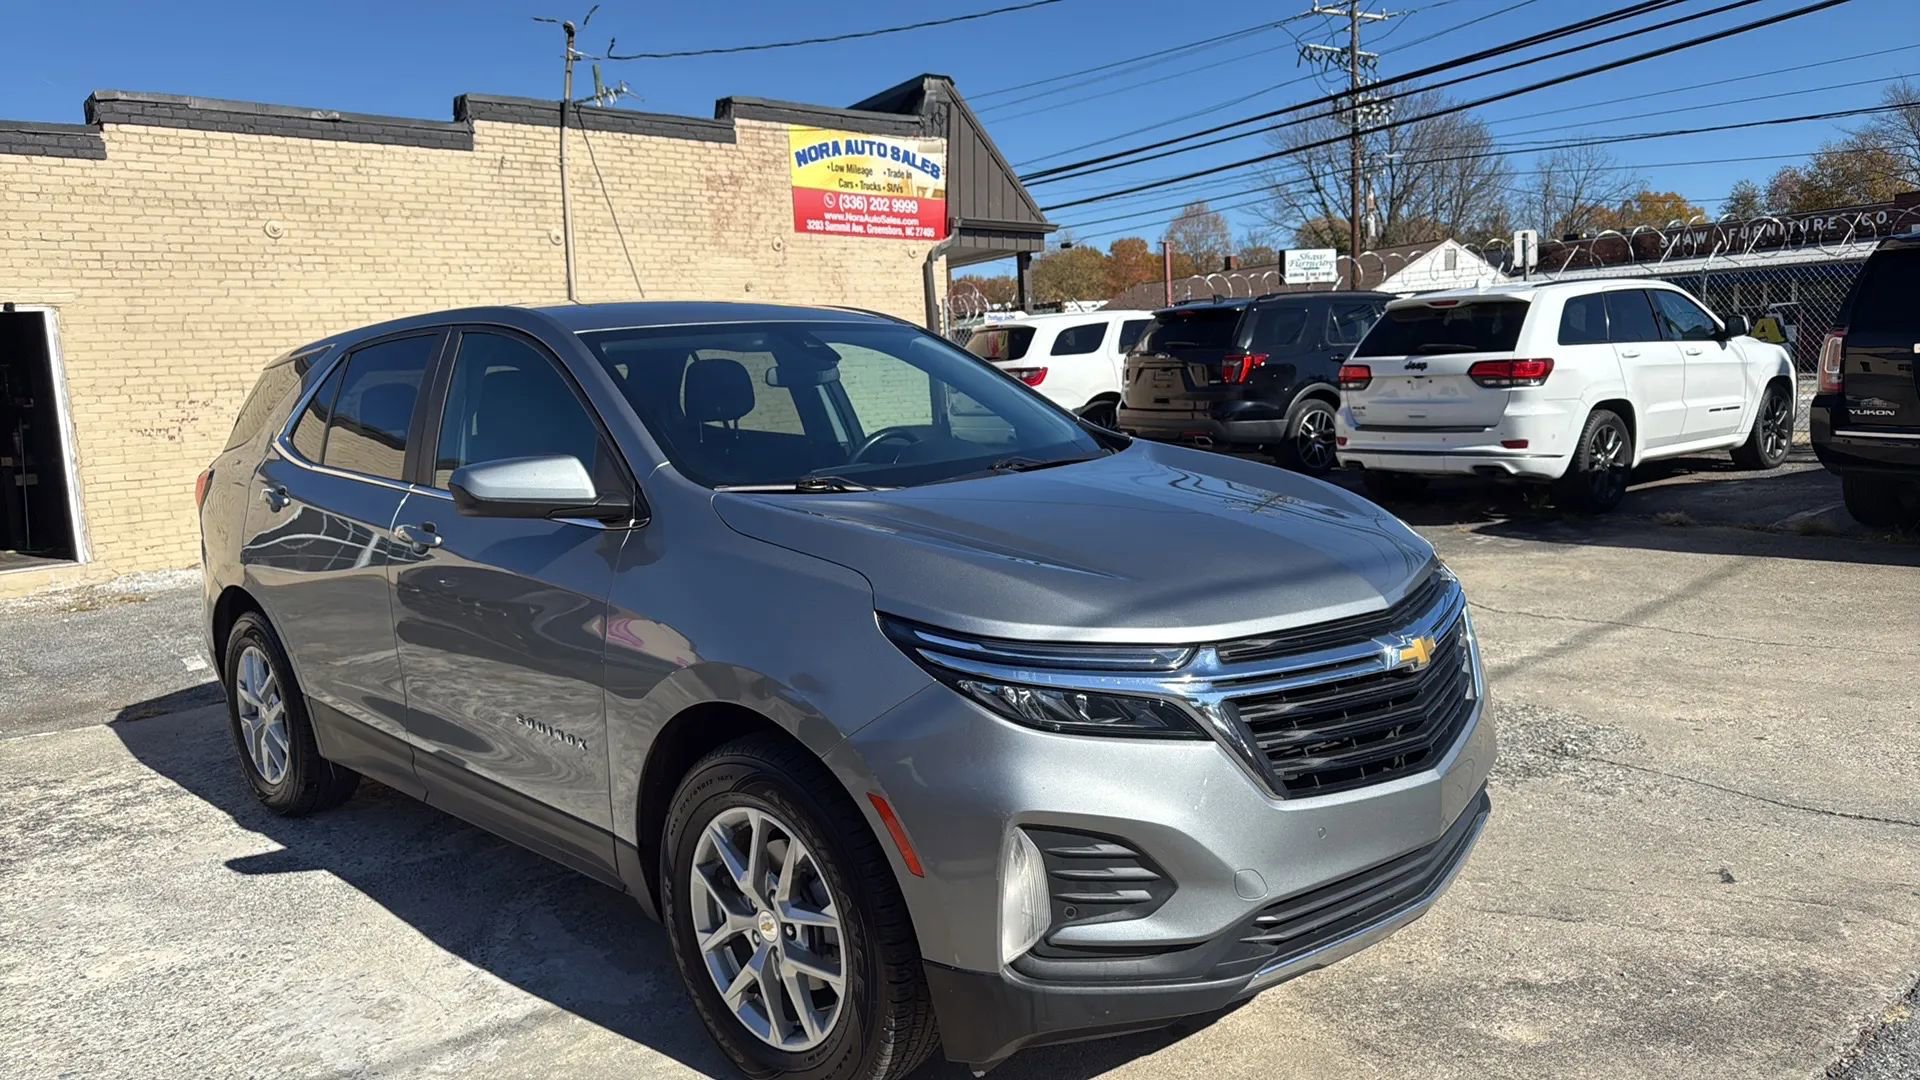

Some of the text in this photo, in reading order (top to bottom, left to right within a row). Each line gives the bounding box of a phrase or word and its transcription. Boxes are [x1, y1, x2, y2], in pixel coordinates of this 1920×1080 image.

[795, 139, 941, 180] NORA AUTO SALES
[831, 162, 873, 177] Low Mileage
[887, 168, 904, 179] Trade
[838, 178, 904, 193] Cars Trucks SUVs
[839, 195, 918, 215] (336) 202 9999
[824, 212, 919, 226] www.NoraAutoSales.com
[1729, 216, 1838, 241] FURNITURE
[1404, 361, 1428, 371] Jeep
[515, 713, 587, 750] EQUINOX
